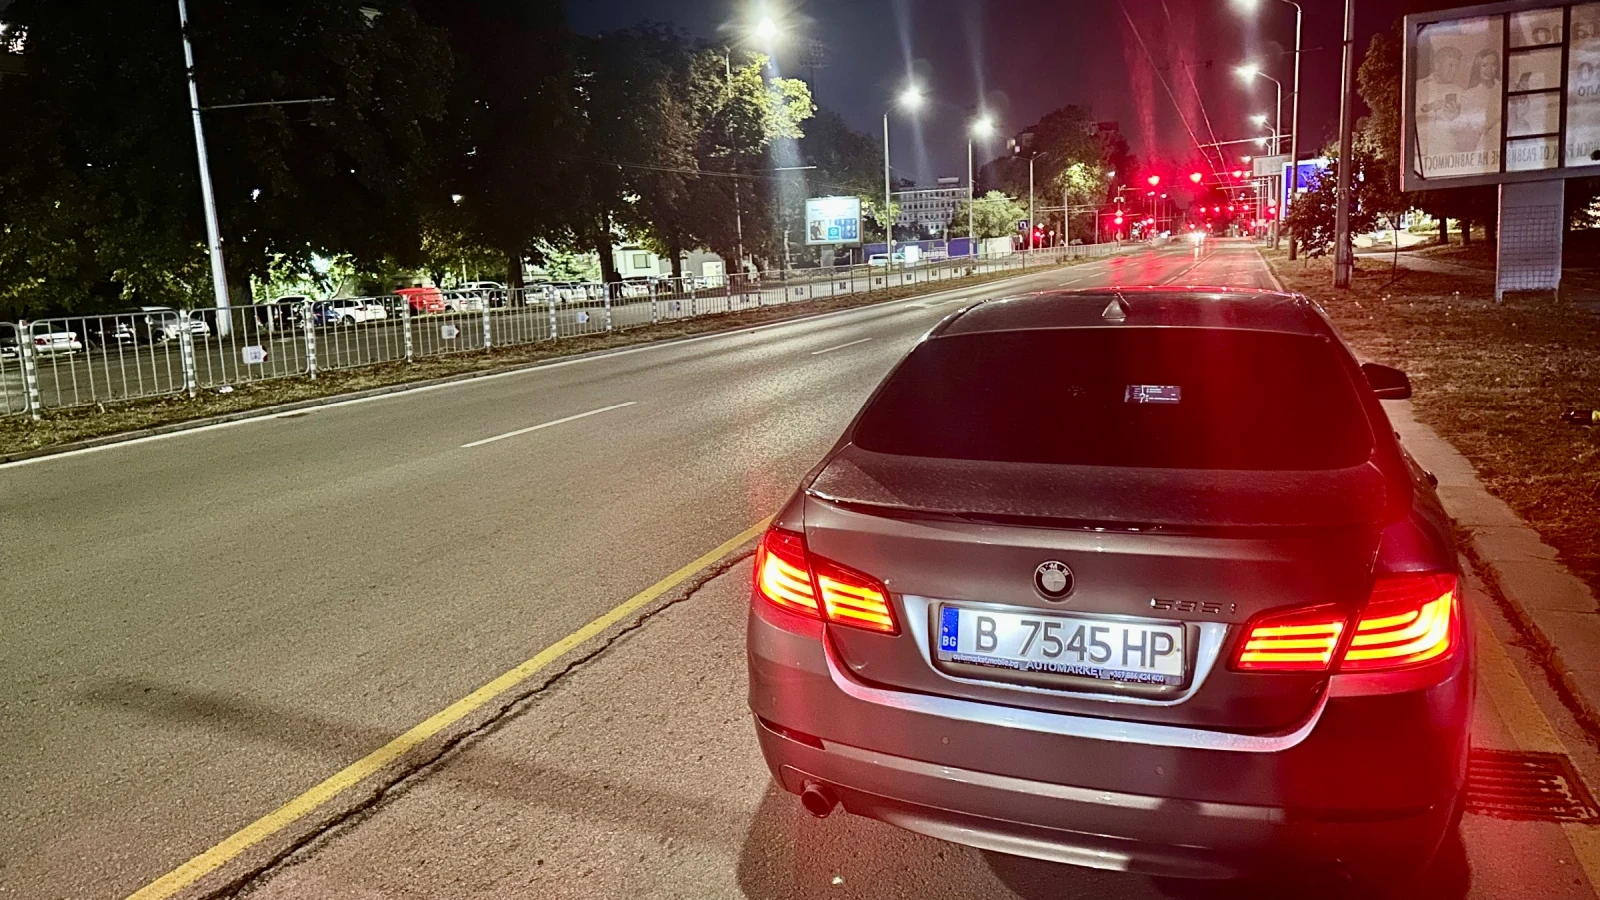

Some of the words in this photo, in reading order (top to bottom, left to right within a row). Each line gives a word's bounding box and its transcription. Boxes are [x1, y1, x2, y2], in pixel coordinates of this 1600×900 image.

[942, 635, 957, 647] BG
[976, 616, 998, 652] B
[1019, 619, 1112, 663] 7545
[1121, 629, 1175, 668] HP
[1026, 660, 1104, 677] AUTOMARKET
